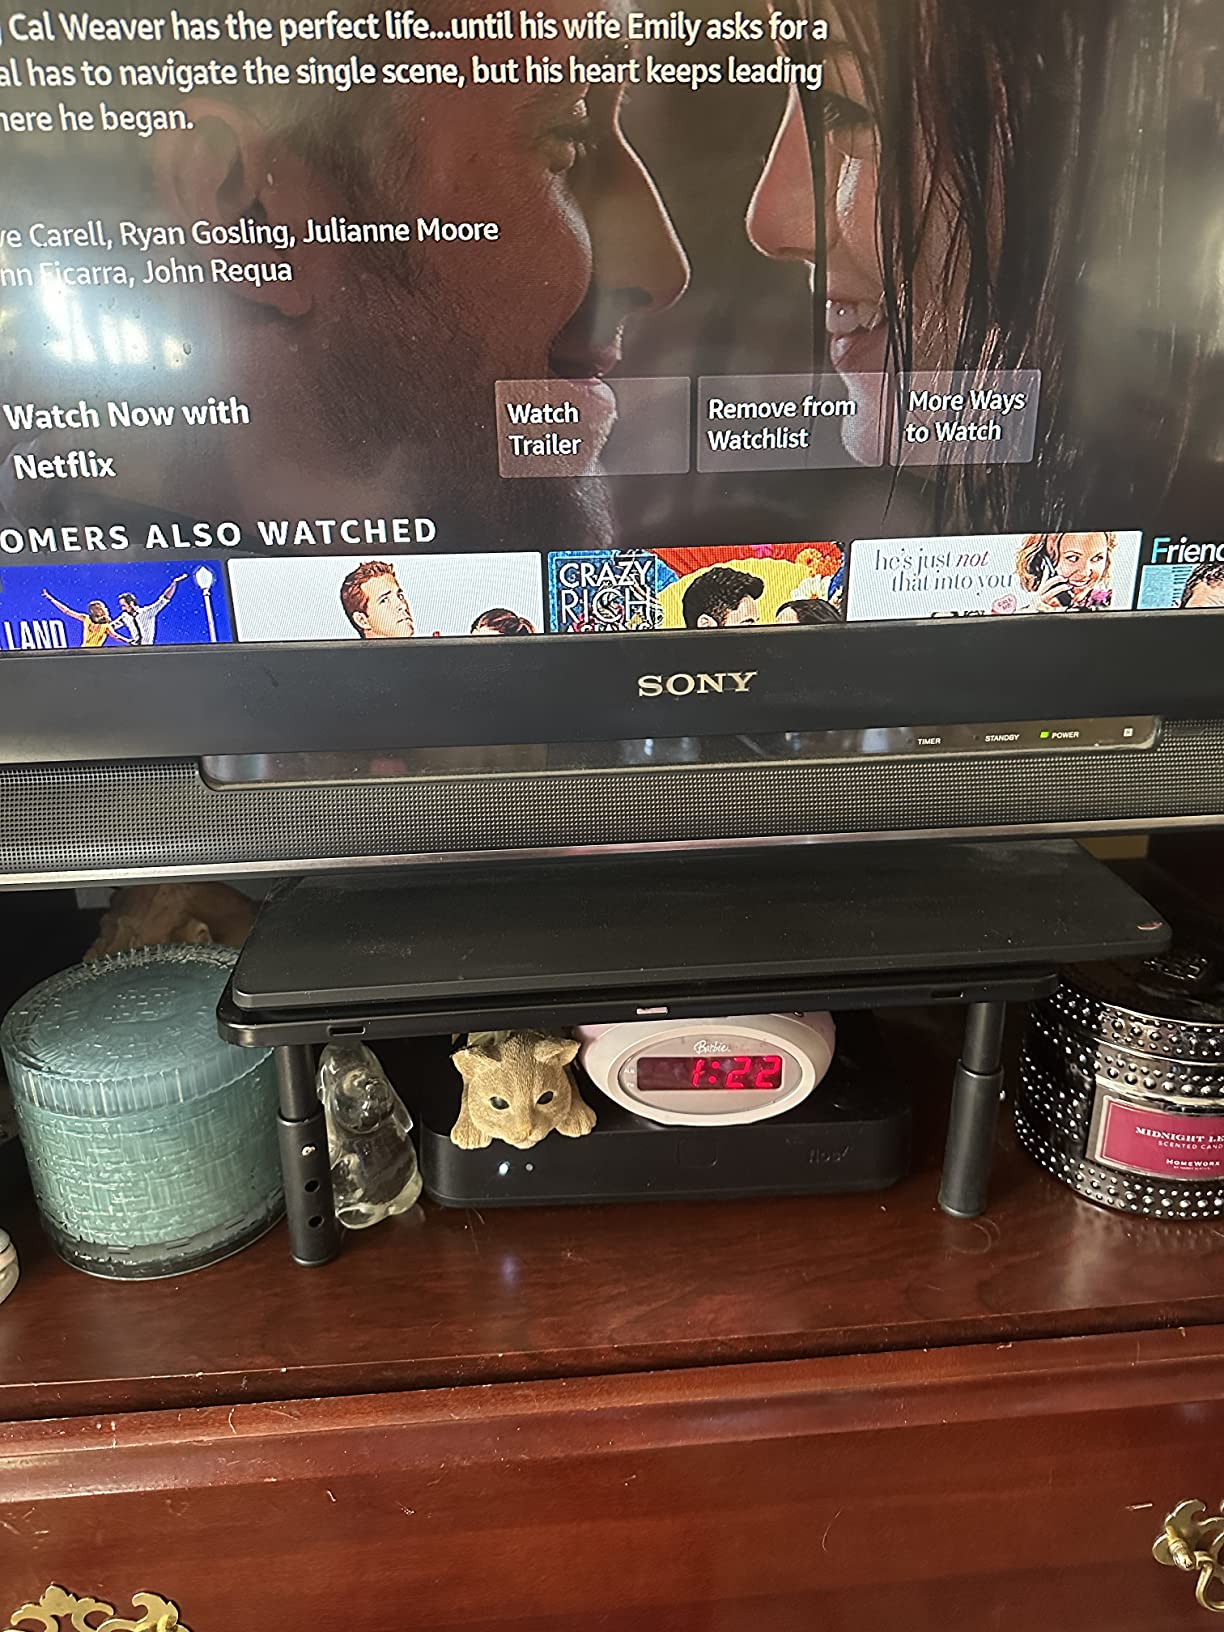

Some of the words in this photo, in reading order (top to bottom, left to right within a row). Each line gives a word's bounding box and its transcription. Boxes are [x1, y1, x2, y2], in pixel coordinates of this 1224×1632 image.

[8, 10, 56, 41] Cal
[58, 12, 166, 41] Weaver
[172, 10, 221, 40] has
[225, 10, 274, 40] the
[279, 9, 381, 47] perfect
[385, 8, 514, 40] life...until
[519, 9, 559, 39] his
[563, 8, 621, 39] wife
[627, 9, 700, 44] Emily
[706, 8, 764, 39] asks
[769, 8, 809, 39] for
[812, 17, 828, 39] a
[26, 57, 76, 87] has
[80, 60, 113, 86] to
[119, 57, 236, 93] navigate
[241, 56, 291, 85] the
[296, 54, 376, 91] single
[382, 61, 466, 88] scene,
[472, 54, 519, 84] but
[525, 54, 564, 84] his
[570, 54, 640, 84] heart
[646, 54, 723, 89] keeps
[728, 53, 823, 89] leading
[58, 102, 94, 131] he
[99, 101, 194, 137] began.
[29, 220, 112, 250] Carell,
[119, 221, 185, 250] Ryan
[191, 219, 296, 250] Gosling,
[302, 216, 410, 245] Julianne
[417, 217, 499, 242] Moore
[39, 261, 135, 289] Ficarra,
[142, 258, 204, 284] John
[211, 259, 293, 288] Requa
[3, 400, 100, 431] Watch
[107, 401, 173, 428] Now
[183, 396, 251, 425] with
[507, 401, 580, 425] Watch
[708, 397, 798, 421] Remove
[802, 395, 857, 418] from
[908, 389, 965, 412] More
[970, 388, 1026, 415] Ways
[708, 426, 809, 451] Watchlist
[905, 423, 929, 443] to
[935, 418, 1002, 442] Watch
[508, 434, 582, 457] Trailer
[14, 450, 117, 480] Netflix
[0, 525, 129, 554] OMERS
[145, 522, 242, 549] ALSO
[257, 517, 437, 546] WATCHED
[559, 560, 653, 588] CRAZY
[875, 548, 913, 571] he's
[917, 548, 951, 576] just
[956, 550, 989, 568] not
[892, 570, 929, 592] that
[934, 569, 973, 590] into
[977, 572, 1013, 596] you
[561, 588, 654, 625] RICH
[3, 619, 68, 651] LAND
[637, 670, 757, 698] SONY
[917, 737, 942, 746] TIMER
[984, 733, 1020, 743] STANDBY
[1051, 731, 1080, 739] POWER
[693, 1039, 729, 1054] Barbie
[692, 1055, 782, 1088] 1:22
[1135, 1127, 1205, 1142] MIDNIGHT
[1158, 1141, 1197, 1149] SCENTED
